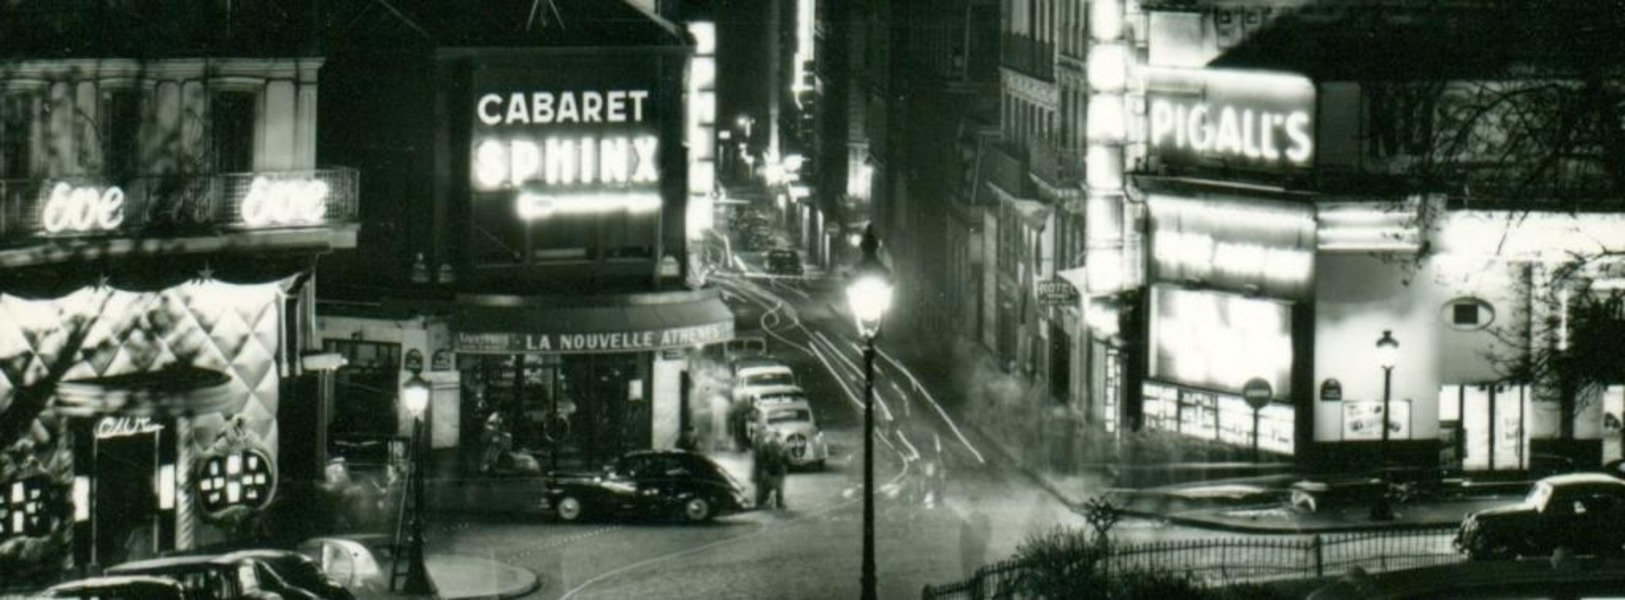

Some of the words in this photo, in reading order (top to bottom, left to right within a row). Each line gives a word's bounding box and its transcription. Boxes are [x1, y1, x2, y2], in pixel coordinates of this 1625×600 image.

[477, 91, 648, 125] CABARET
[1150, 99, 1313, 163] PIGALL'S
[475, 135, 659, 188] SPHINX
[526, 334, 551, 351] LA
[559, 330, 654, 350] NOUVELLE
